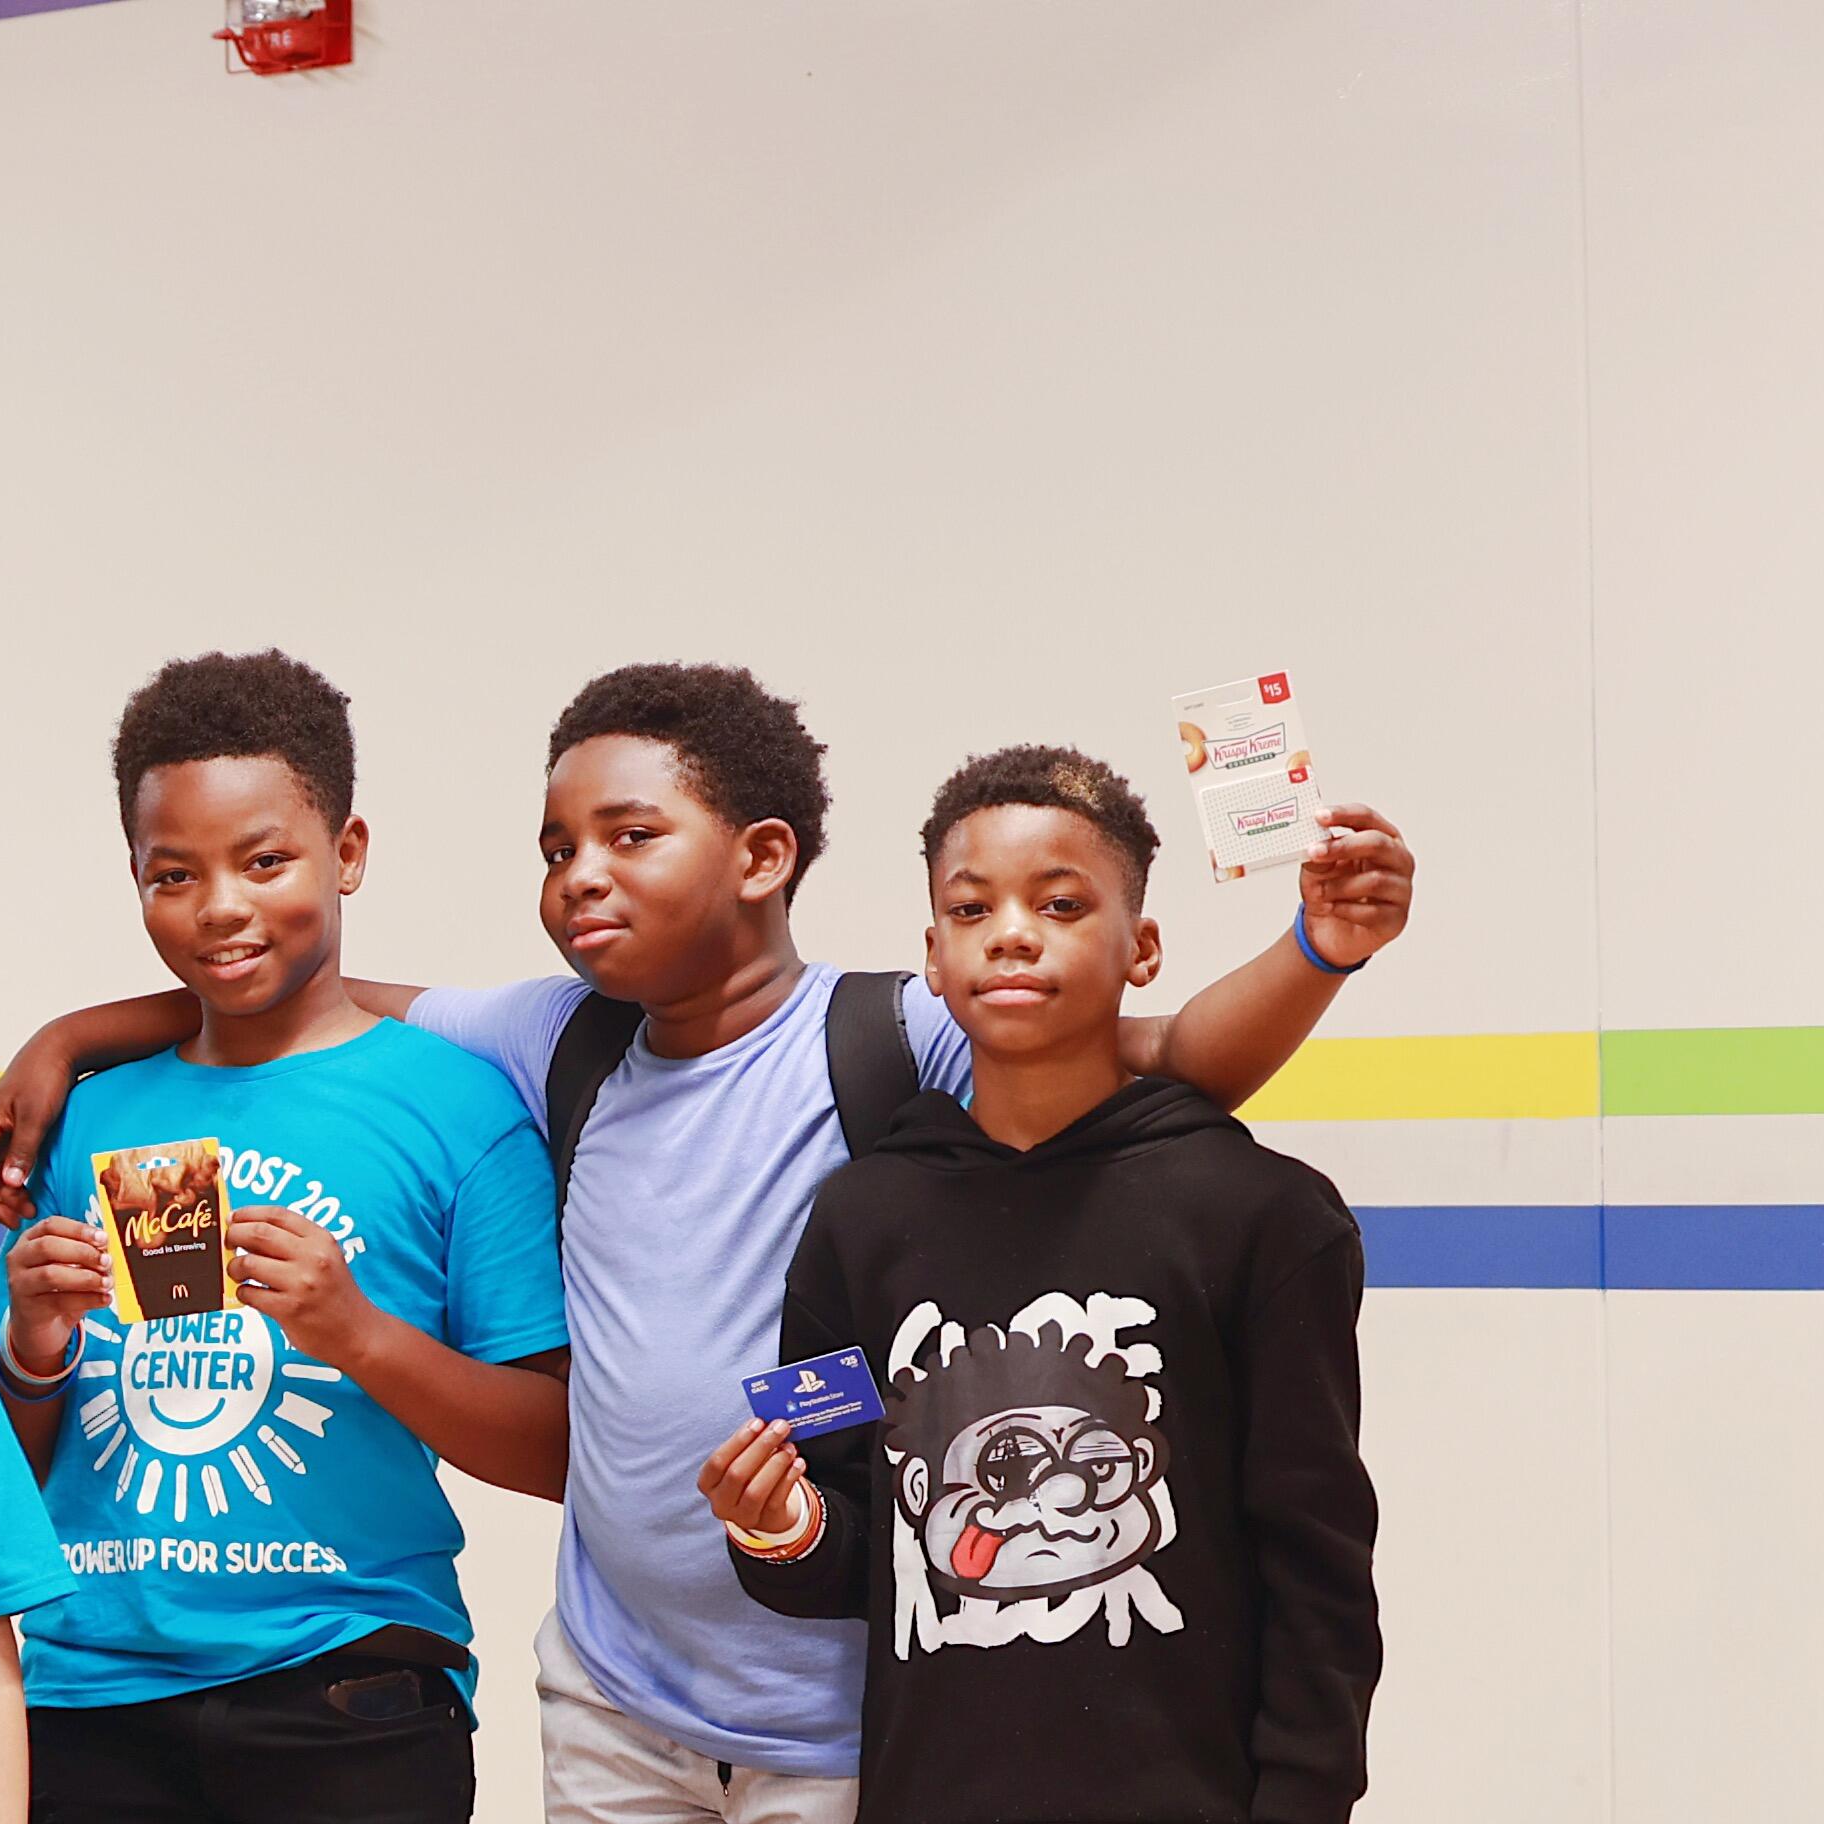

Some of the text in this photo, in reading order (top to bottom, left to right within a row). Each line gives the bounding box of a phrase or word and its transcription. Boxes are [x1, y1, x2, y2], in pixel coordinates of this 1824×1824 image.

[1263, 682, 1283, 697] $15
[125, 1200, 212, 1246] McCafé
[143, 1242, 206, 1257] Good is Brewing
[145, 1310, 243, 1345] POWER
[130, 1350, 254, 1391] CENTER
[127, 1538, 156, 1572] UP
[160, 1538, 218, 1574] FOR
[225, 1541, 348, 1574] SUCCESS
